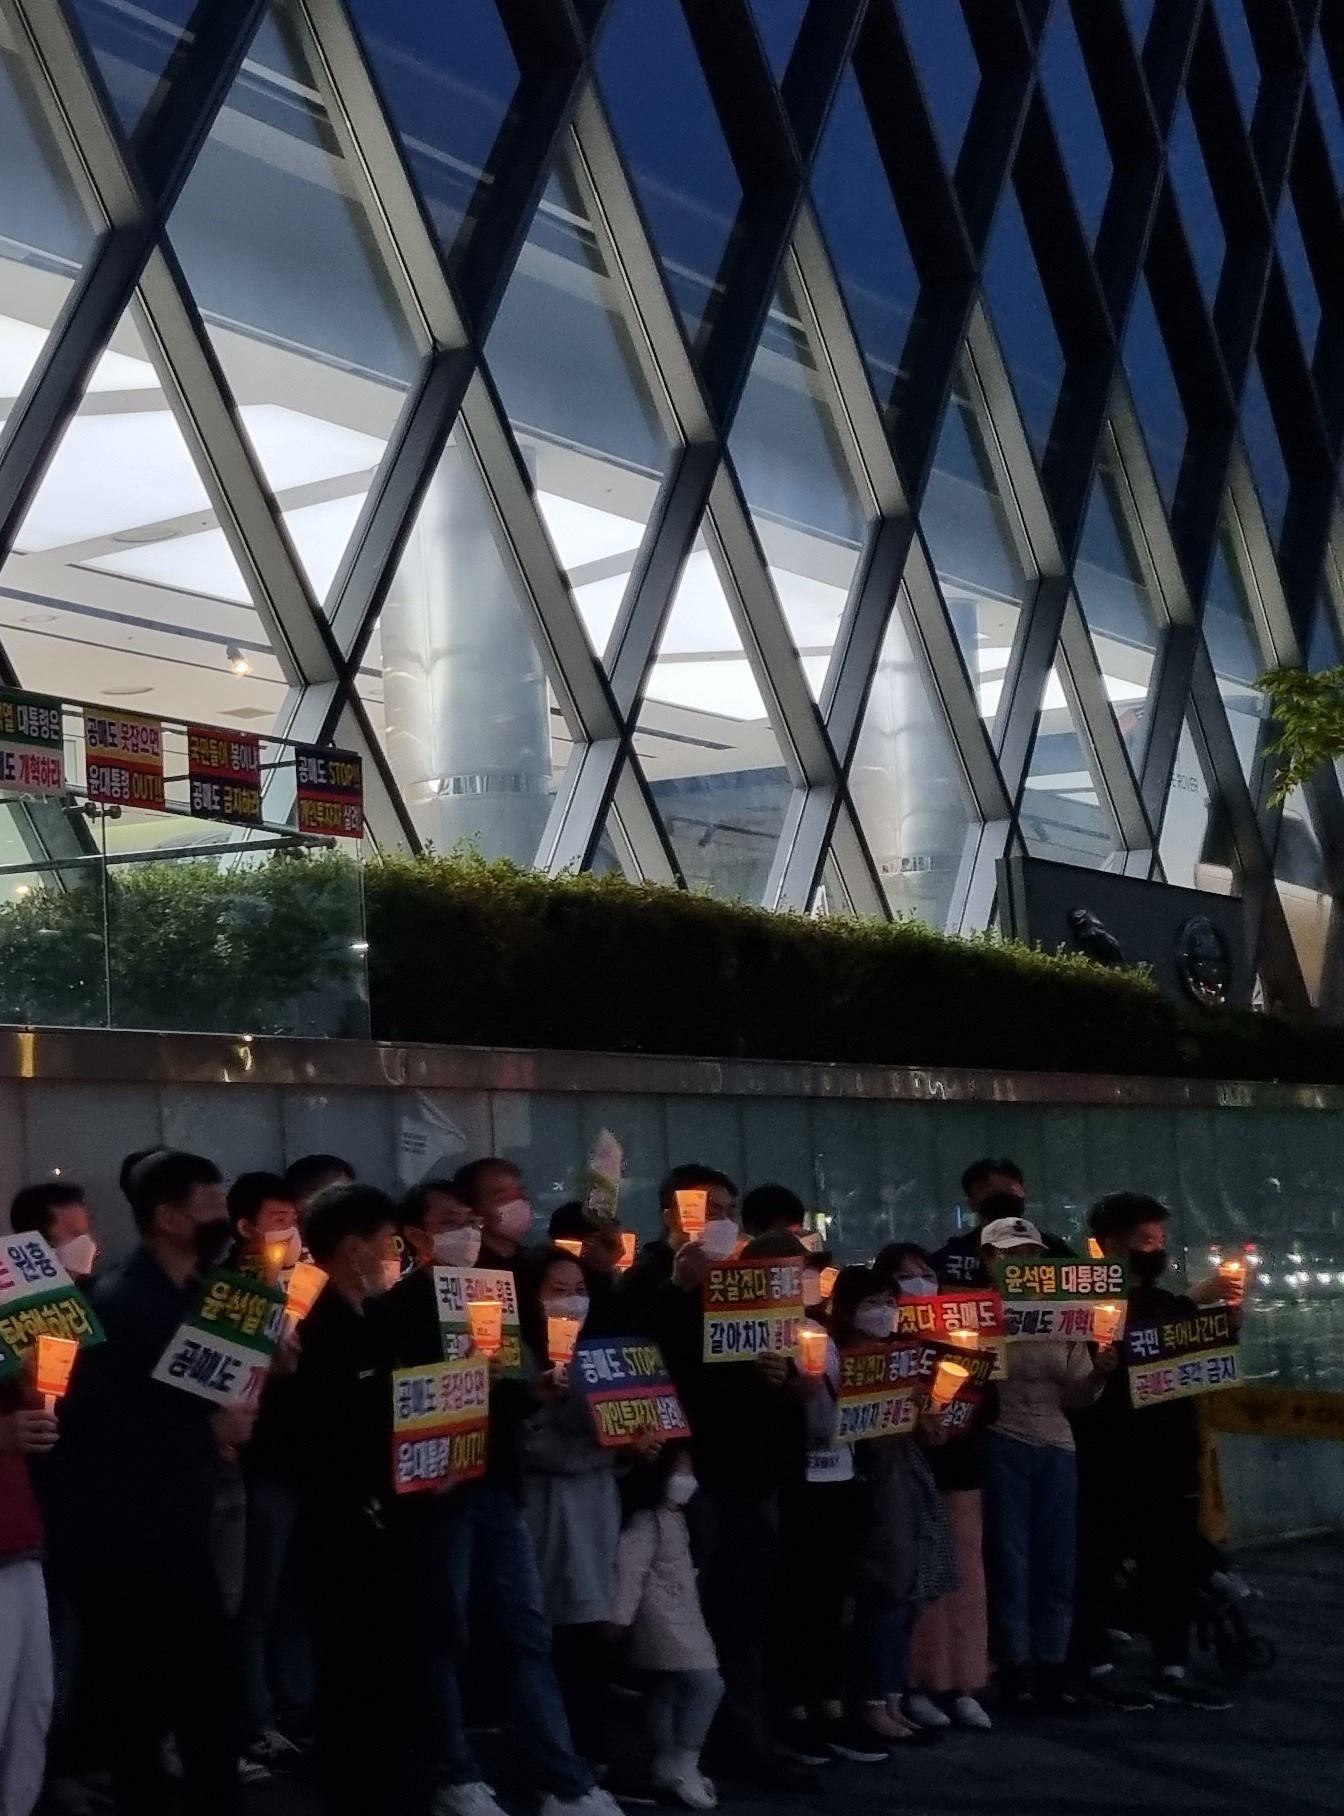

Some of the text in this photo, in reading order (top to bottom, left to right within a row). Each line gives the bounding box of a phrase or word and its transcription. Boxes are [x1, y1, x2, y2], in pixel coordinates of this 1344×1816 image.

[16, 703, 61, 740] 대통령은
[87, 717, 118, 748] 공매도
[19, 753, 61, 788] 개혁하라
[192, 780, 222, 812] 공매도
[708, 1267, 767, 1303] 못살겠다
[1004, 1264, 1124, 1294] 윤석열 대통령은
[897, 1301, 998, 1333] 겠다 공매도
[1007, 1308, 1092, 1336] 공매도 개혁
[710, 1319, 770, 1354] 갈아치자
[1129, 1327, 1161, 1357] 국민
[576, 1347, 627, 1384] 공매도
[1207, 1354, 1238, 1384] 금지
